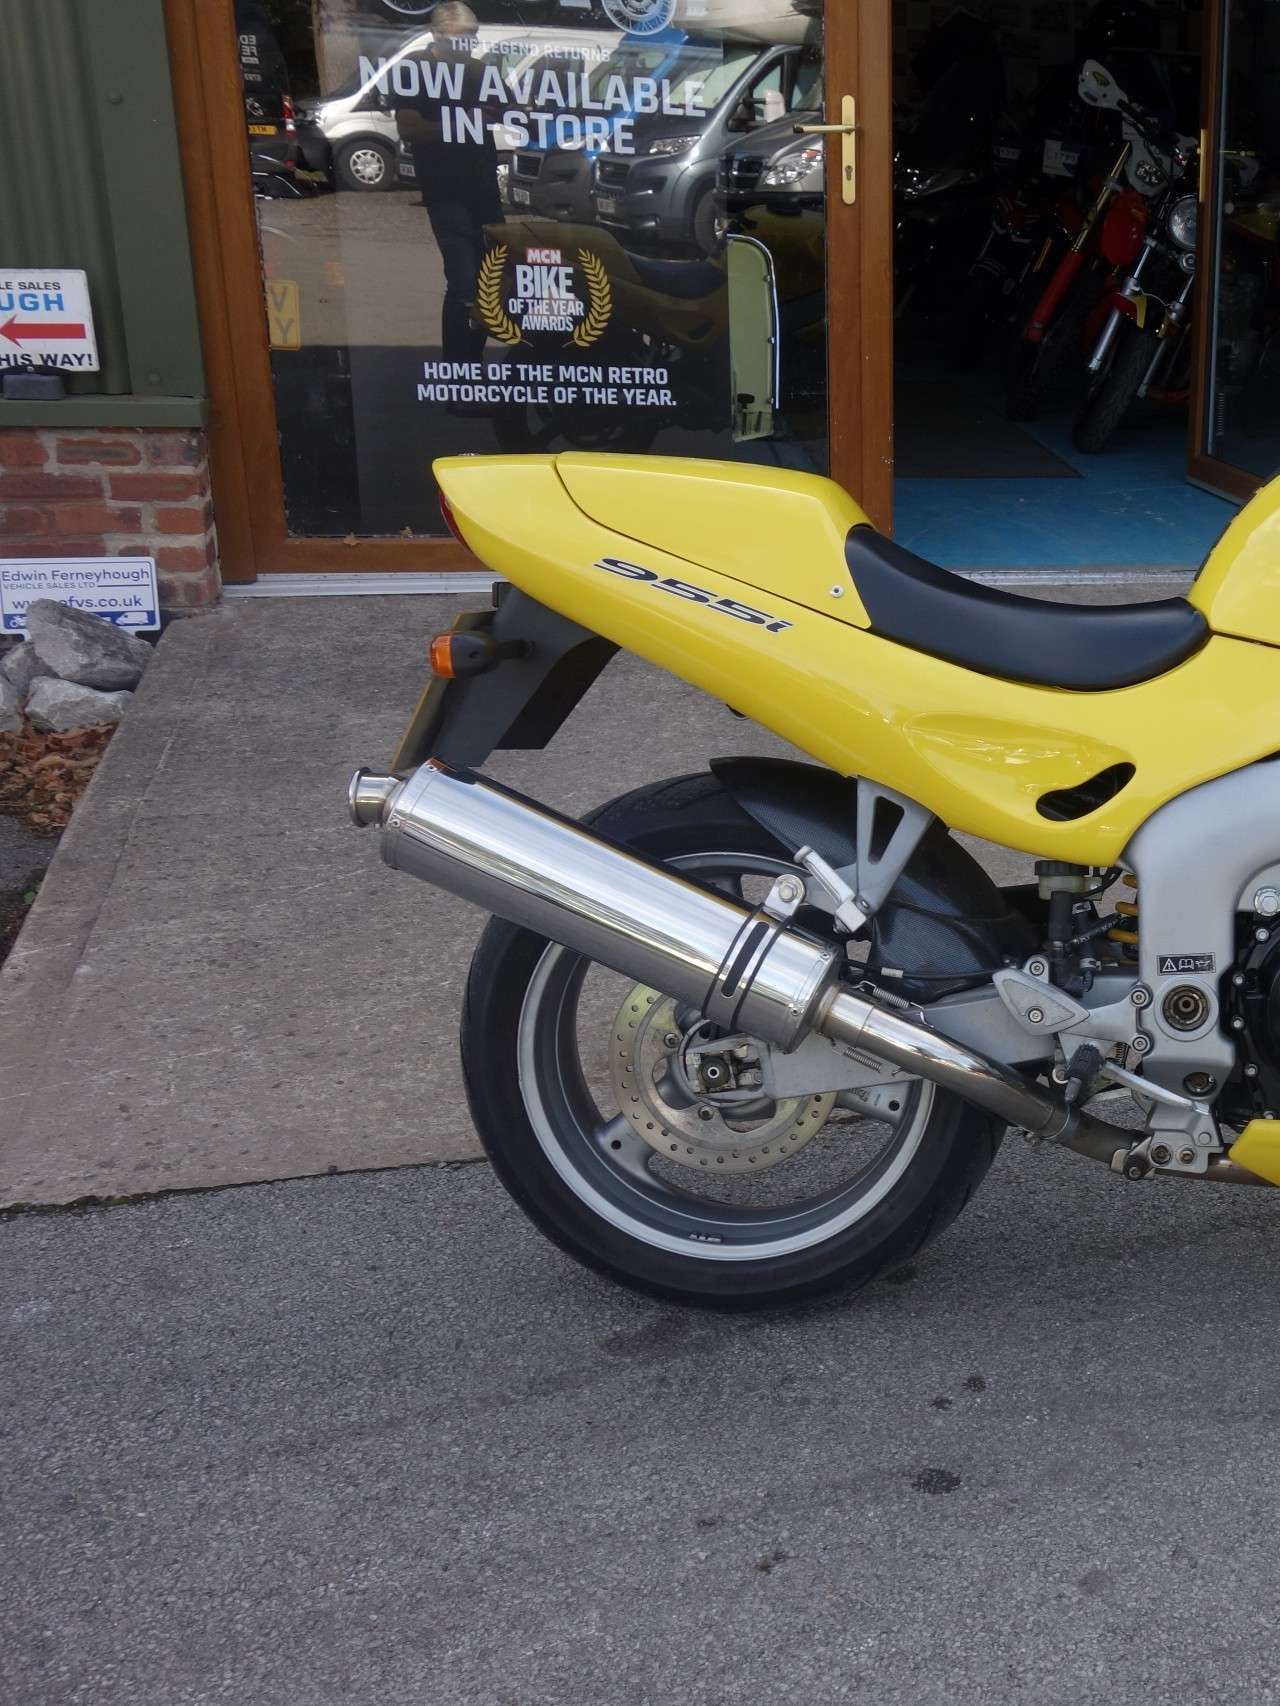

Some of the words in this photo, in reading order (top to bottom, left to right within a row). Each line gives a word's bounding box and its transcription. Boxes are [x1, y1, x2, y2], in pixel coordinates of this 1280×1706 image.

[450, 36, 481, 51] THE
[482, 39, 540, 56] LEGEND
[543, 44, 611, 62] RETURNS
[359, 56, 465, 100] NOW
[479, 65, 706, 117] AVAILABLE
[440, 105, 636, 155] IN-STORE
[526, 249, 562, 263] MCN
[18, 282, 61, 290] SALES
[515, 264, 577, 300] BIKE
[508, 300, 524, 315] OF
[527, 301, 550, 316] THE
[552, 302, 585, 317] YEAR
[521, 315, 575, 333] AWARDS
[38, 353, 94, 367] WAY!
[424, 361, 483, 381] HOME
[487, 363, 512, 382] OF
[516, 364, 553, 383] THE
[559, 365, 604, 384] MCN
[607, 367, 669, 386] RETRO
[417, 384, 549, 405] MOTORCYCLE
[553, 387, 577, 406] OF
[582, 387, 619, 406] THE
[622, 388, 678, 407] YEAR.
[2, 570, 48, 582] Edwin
[51, 568, 150, 583] Ferneyhough
[593, 558, 793, 633] 955i
